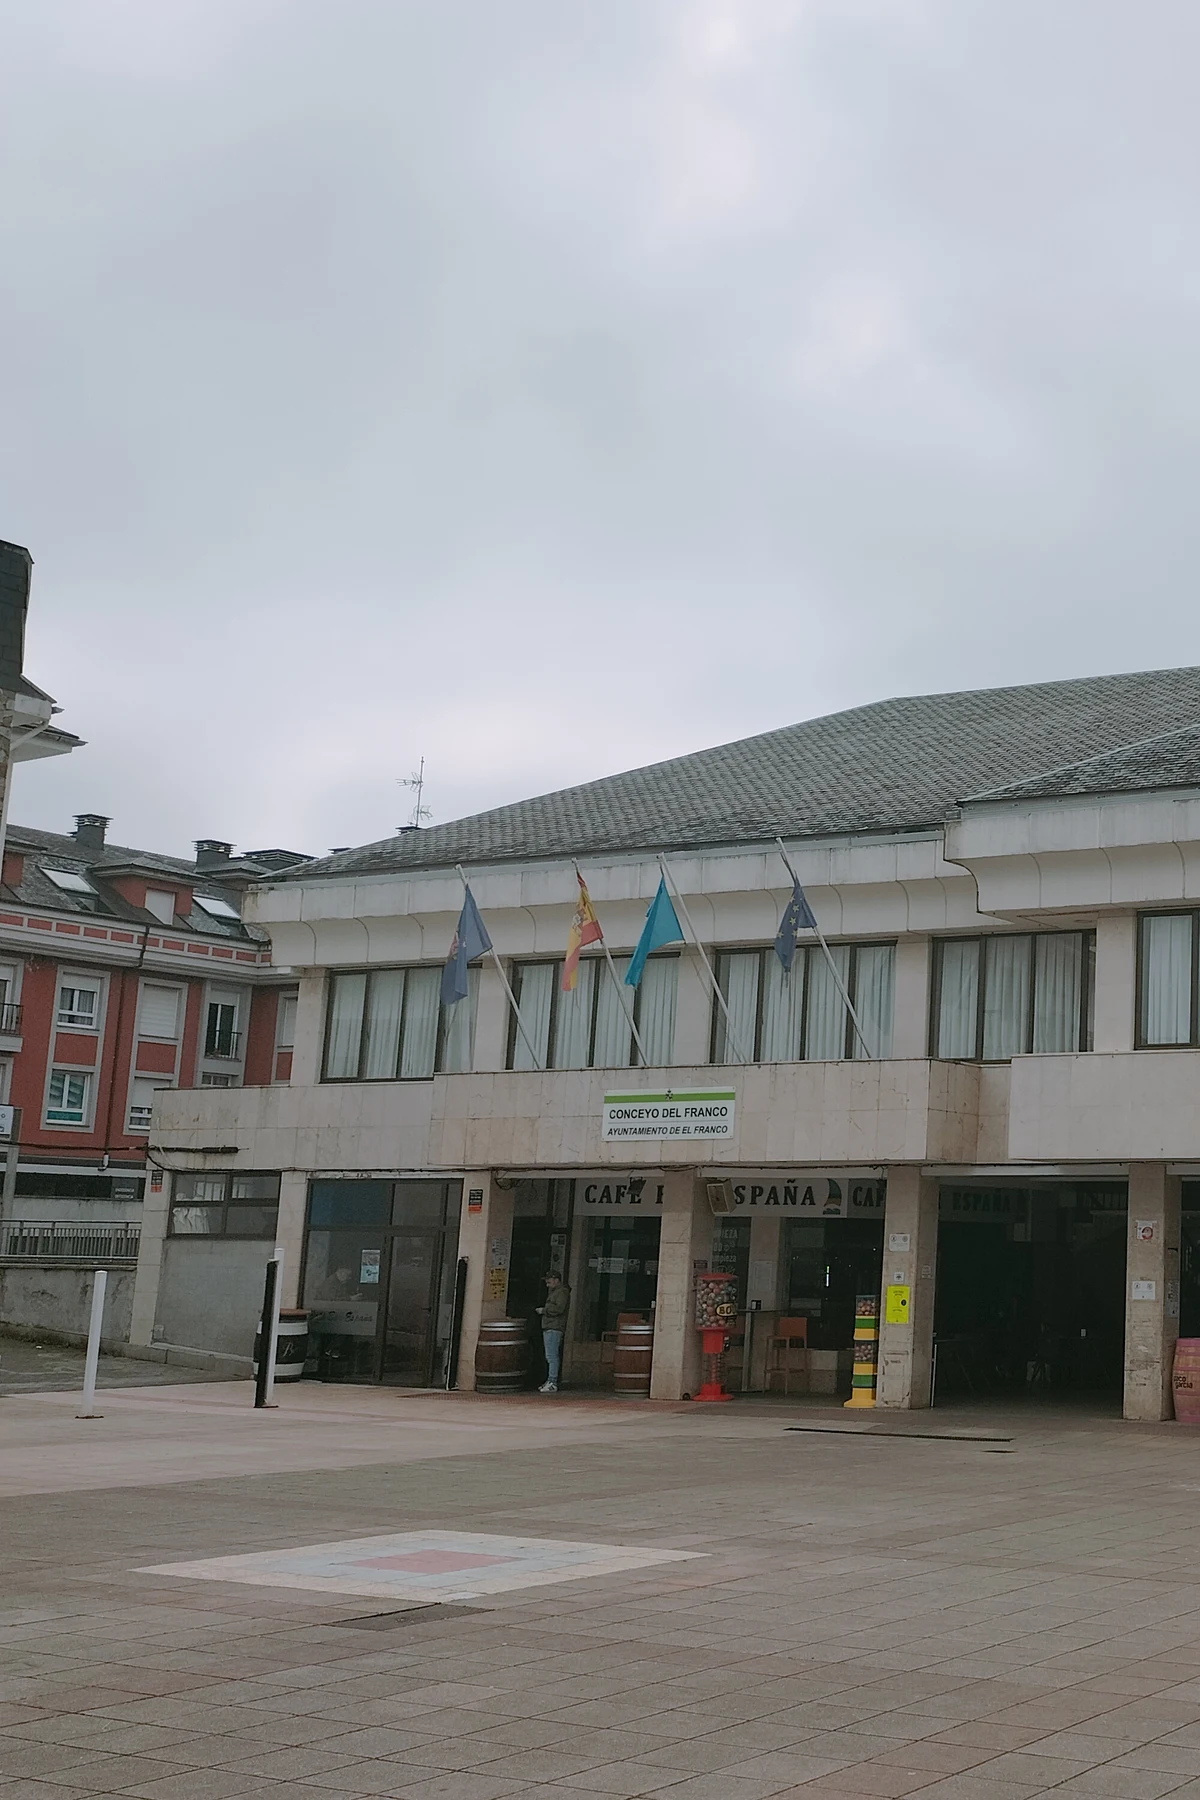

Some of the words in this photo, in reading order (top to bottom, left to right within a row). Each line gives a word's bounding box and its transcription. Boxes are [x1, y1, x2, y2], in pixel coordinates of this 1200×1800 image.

[609, 1107, 659, 1119] CONCEYO
[662, 1107, 681, 1118] DEL
[684, 1106, 728, 1117] FRANCO
[607, 1126, 668, 1136] AYUNTAMIENTO
[669, 1126, 680, 1135] DE
[682, 1126, 692, 1134] EL
[693, 1125, 728, 1134] FRANCO
[733, 1179, 816, 1206] SPAÑA
[853, 1186, 886, 1207] CAF
